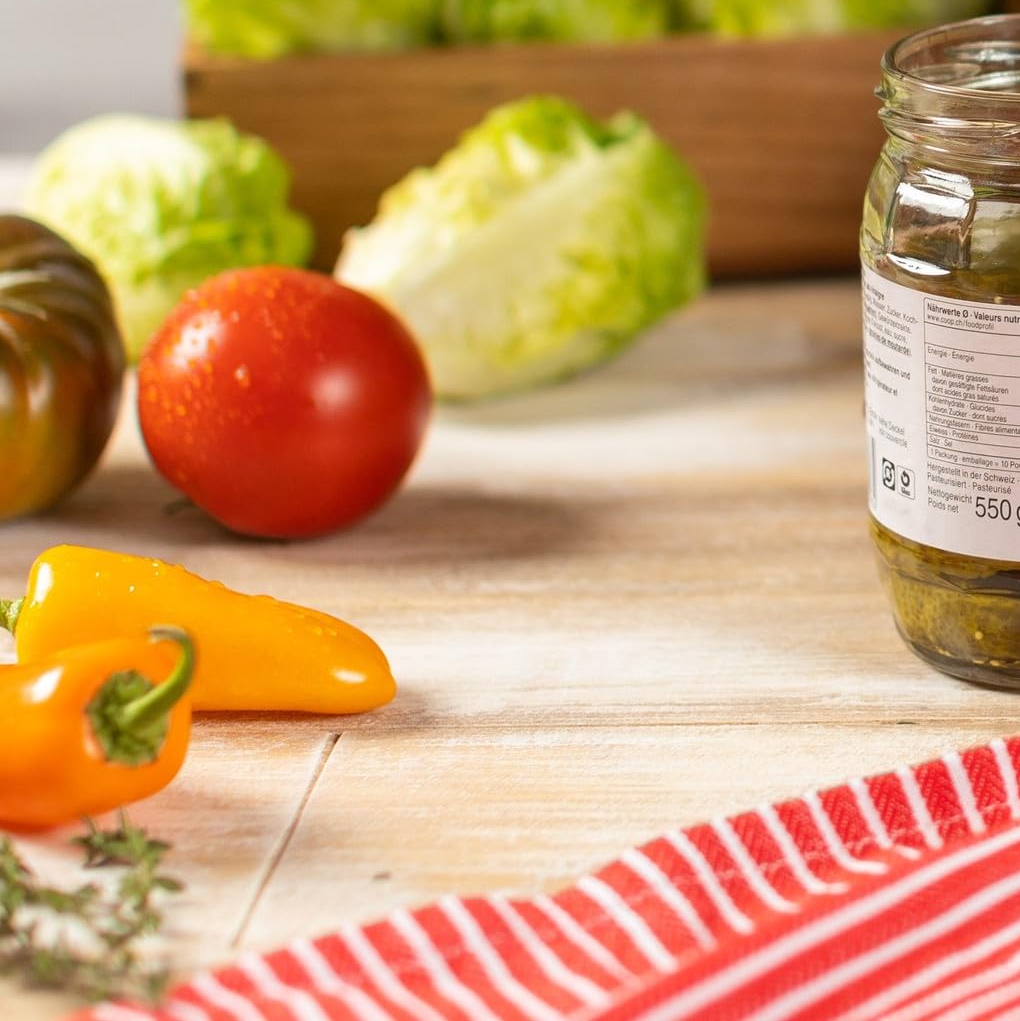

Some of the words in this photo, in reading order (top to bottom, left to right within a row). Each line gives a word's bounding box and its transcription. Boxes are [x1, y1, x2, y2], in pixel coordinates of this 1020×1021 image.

[927, 302, 961, 317] Nährwerte
[973, 311, 1002, 322] Valeurs
[966, 375, 989, 383] grasses
[963, 393, 976, 401] gras
[976, 384, 1009, 394] Fettsäuren
[949, 408, 967, 418] Zucker
[972, 412, 985, 420] dont
[986, 415, 1007, 423] sucres
[969, 402, 995, 413] Glucides
[975, 423, 993, 431] Fibres
[927, 462, 960, 477] Hergestellt
[970, 471, 981, 480] der
[984, 473, 1015, 484] Schweiz
[927, 472, 966, 489] Pasteurisiert
[972, 482, 1012, 494] Pasteurisé
[927, 485, 972, 504] Nettogewicht
[928, 497, 946, 511] Poids
[948, 504, 959, 514] net
[975, 496, 1012, 521] 550
